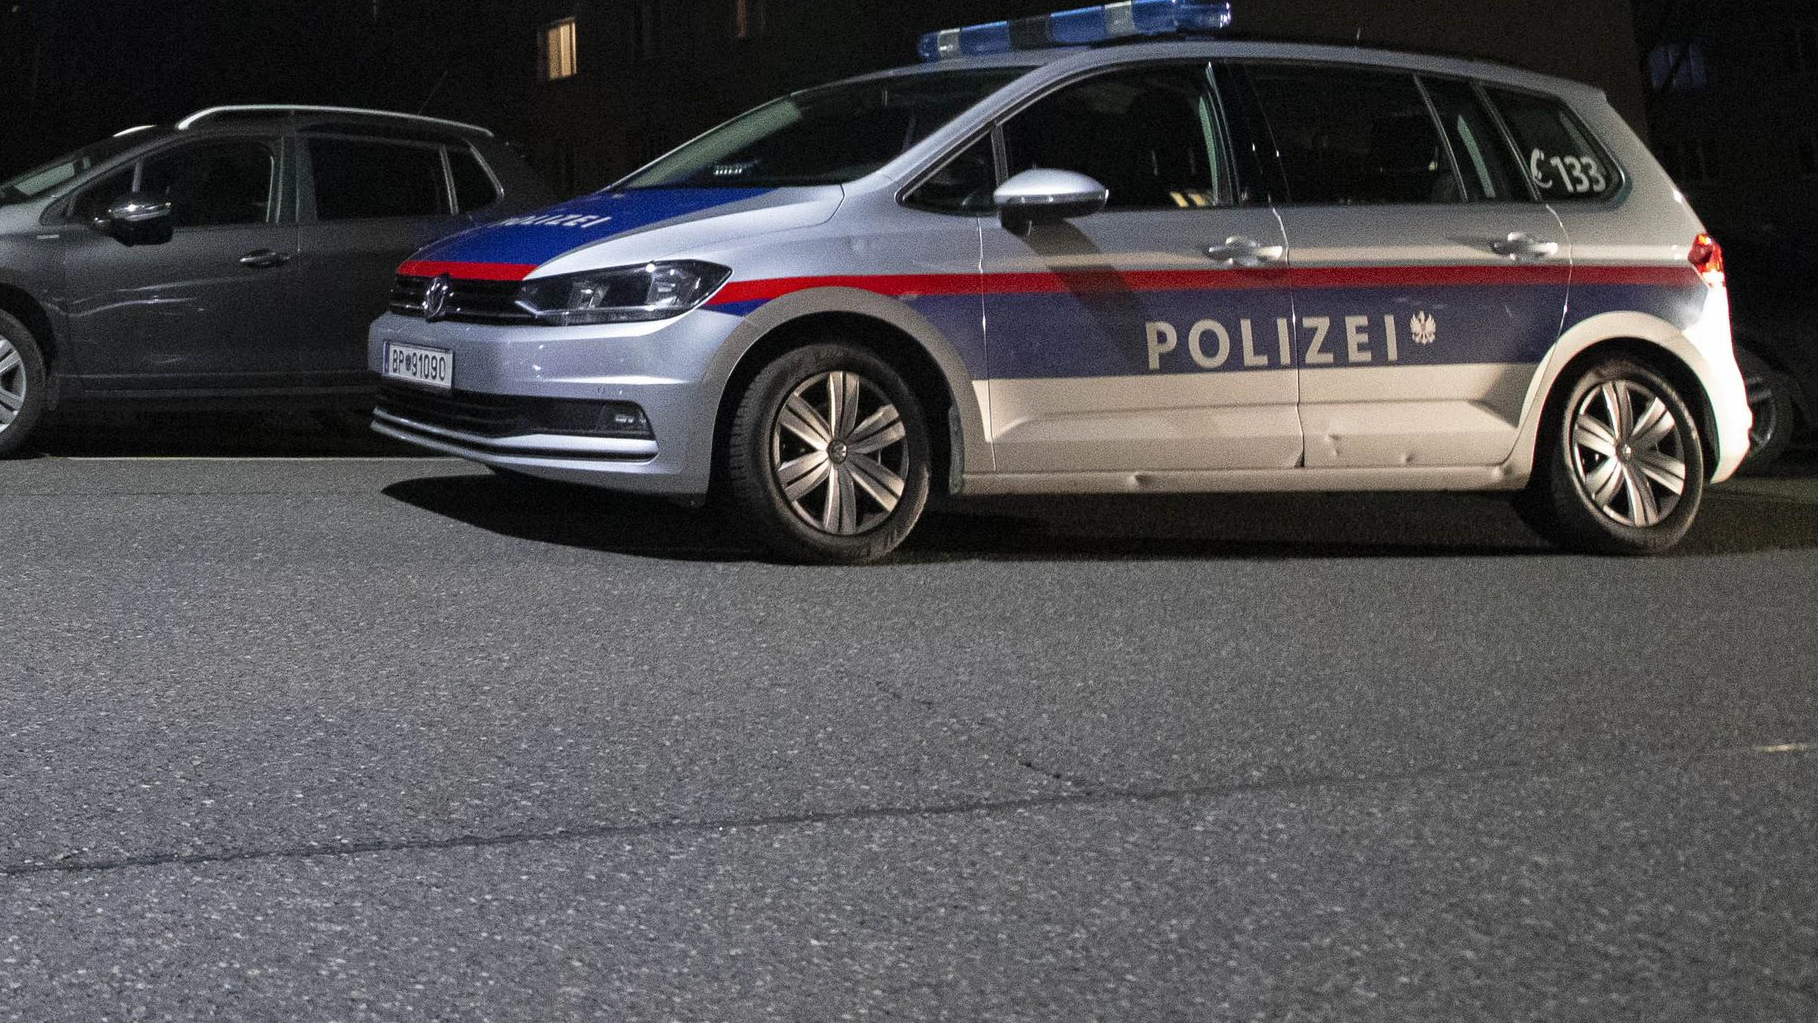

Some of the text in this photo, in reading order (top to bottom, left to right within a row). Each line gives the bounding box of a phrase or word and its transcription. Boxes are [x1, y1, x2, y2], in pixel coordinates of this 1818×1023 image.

[1550, 155, 1606, 193] 133
[1145, 314, 1399, 371] POLIZEI
[392, 349, 446, 381] BP 91090
